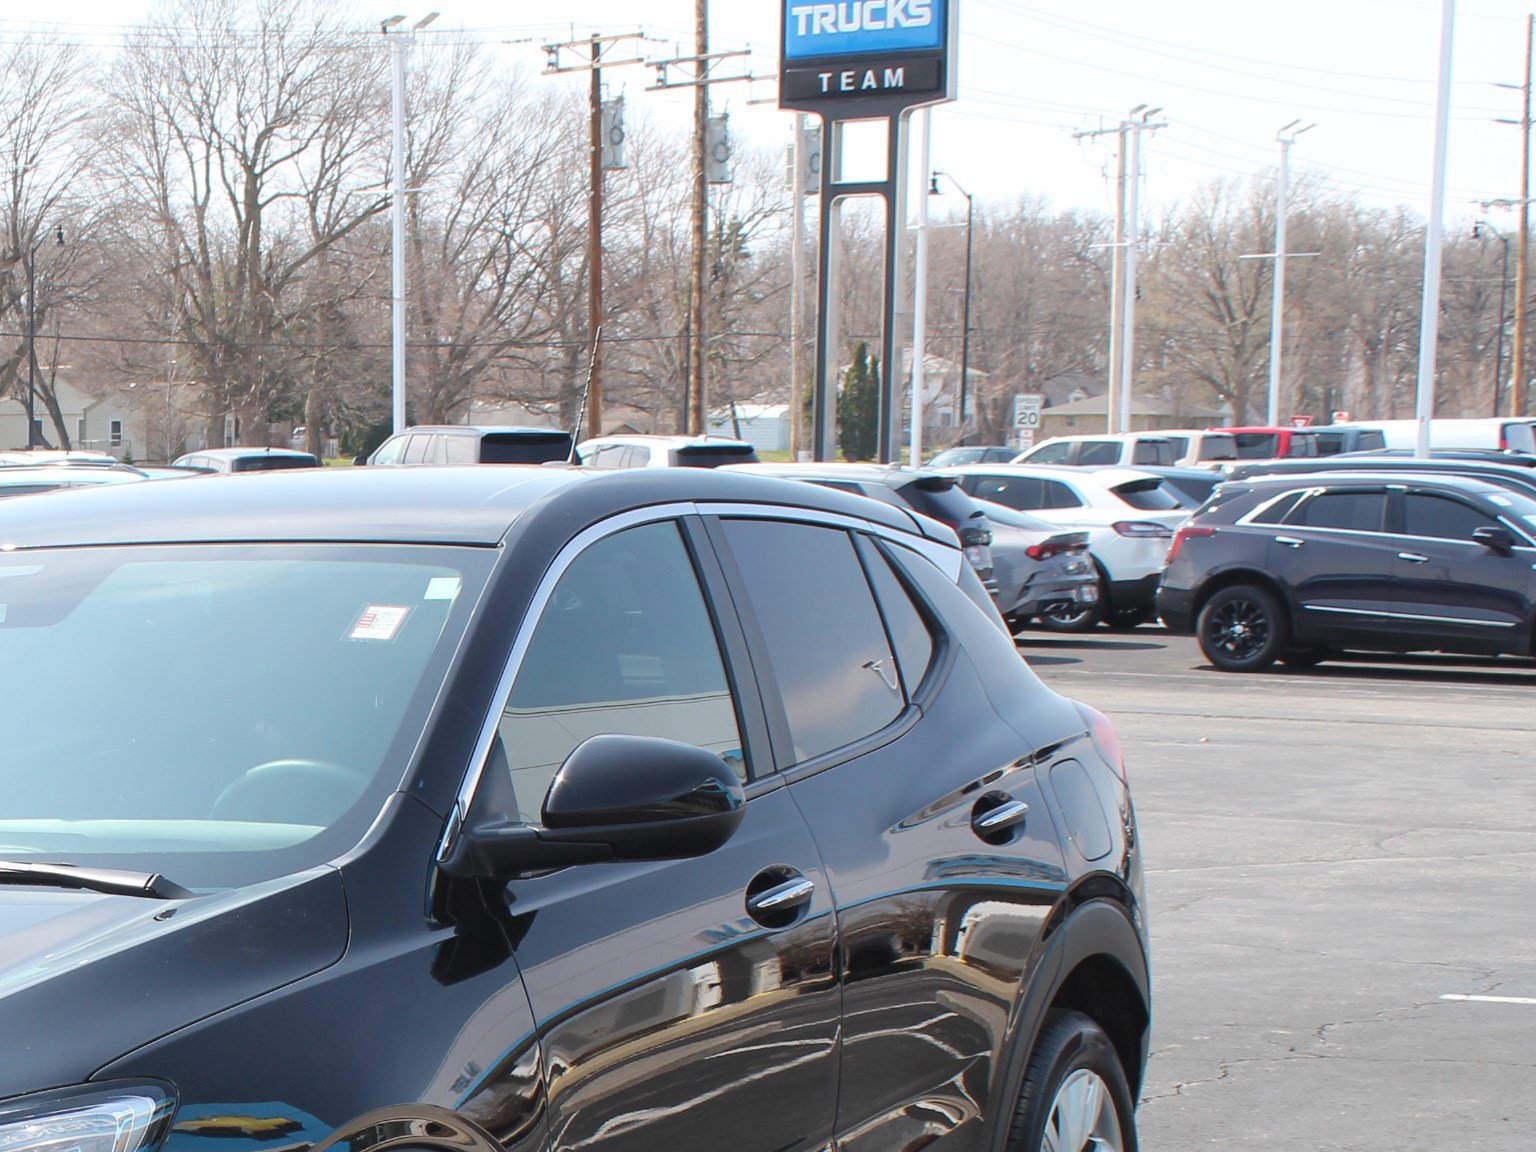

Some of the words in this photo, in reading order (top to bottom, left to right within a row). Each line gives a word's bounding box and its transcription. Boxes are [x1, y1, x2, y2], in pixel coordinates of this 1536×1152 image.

[792, 0, 932, 36] TRUCKS
[818, 67, 904, 92] TEAM
[1017, 412, 1038, 425] 20
